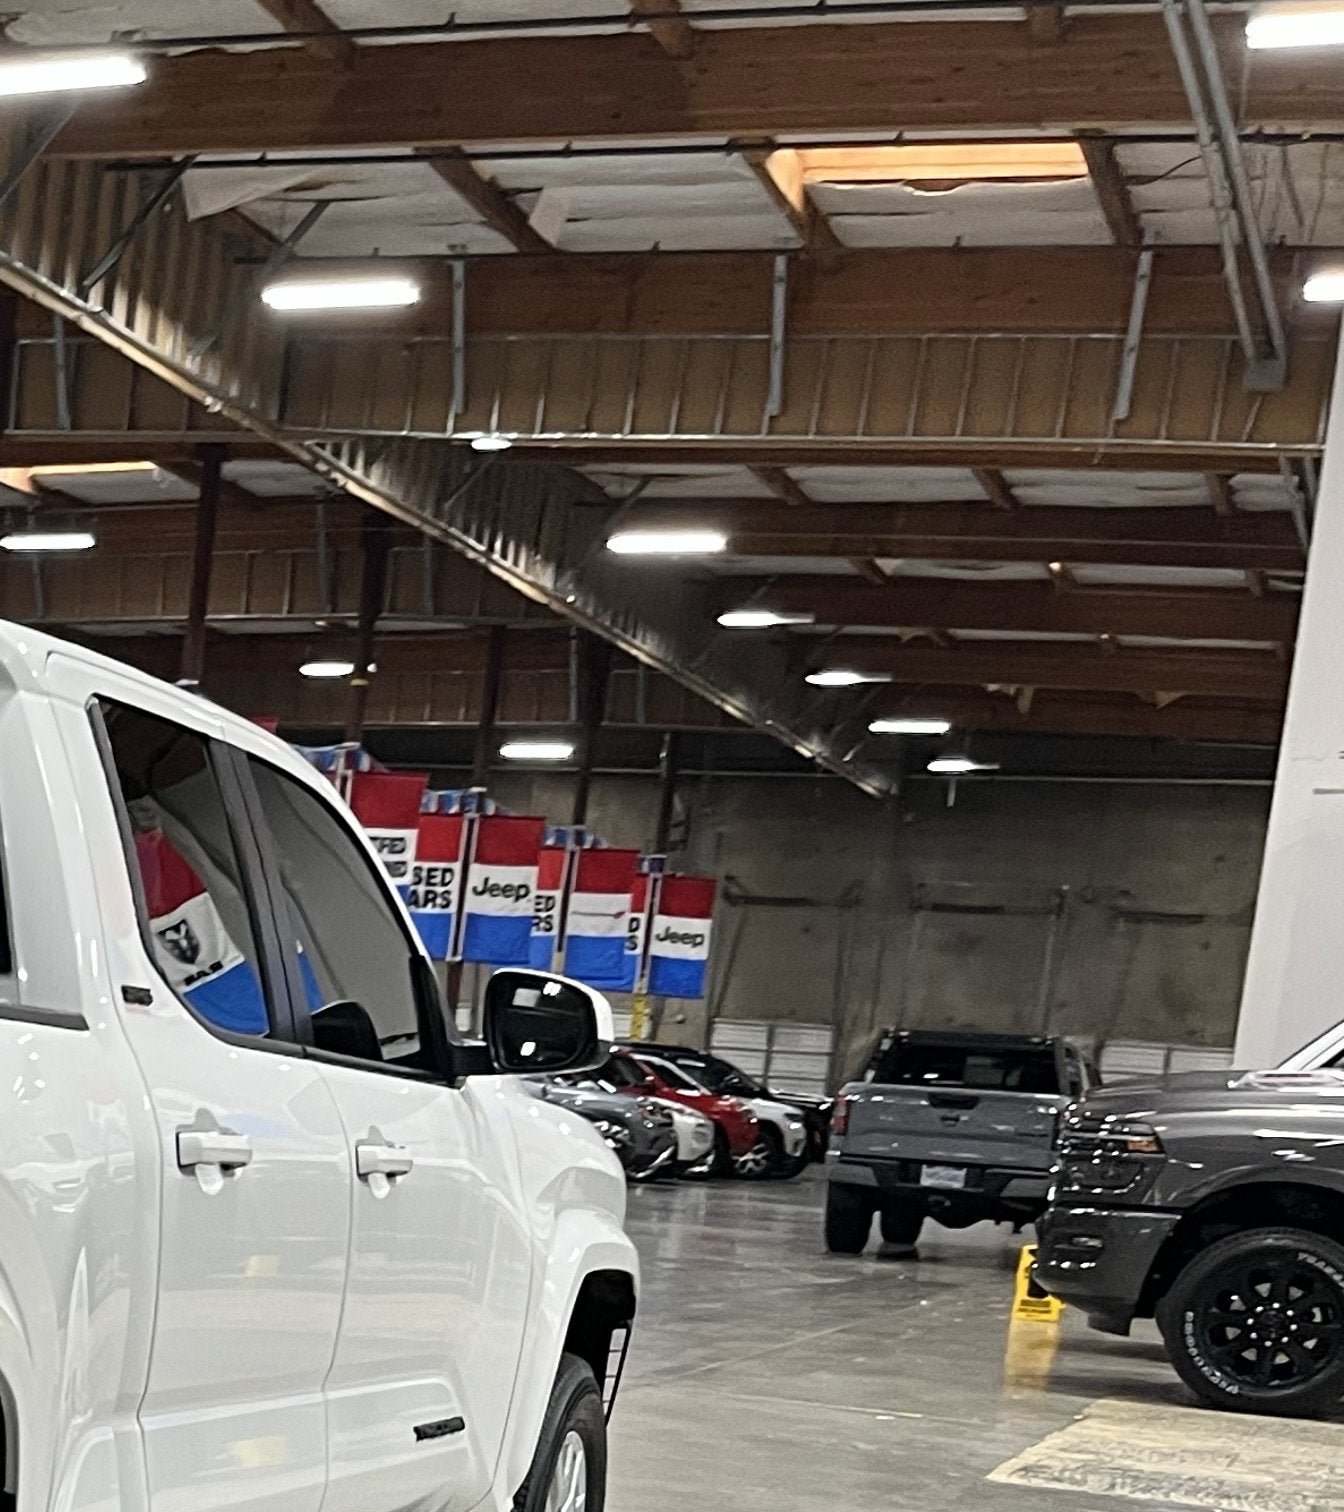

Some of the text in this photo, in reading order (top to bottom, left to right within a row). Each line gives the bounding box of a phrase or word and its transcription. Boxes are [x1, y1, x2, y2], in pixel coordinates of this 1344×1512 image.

[412, 866, 454, 887] SED
[408, 889, 452, 909] ARS
[472, 876, 531, 903] Jeep
[656, 926, 704, 948] Jeep
